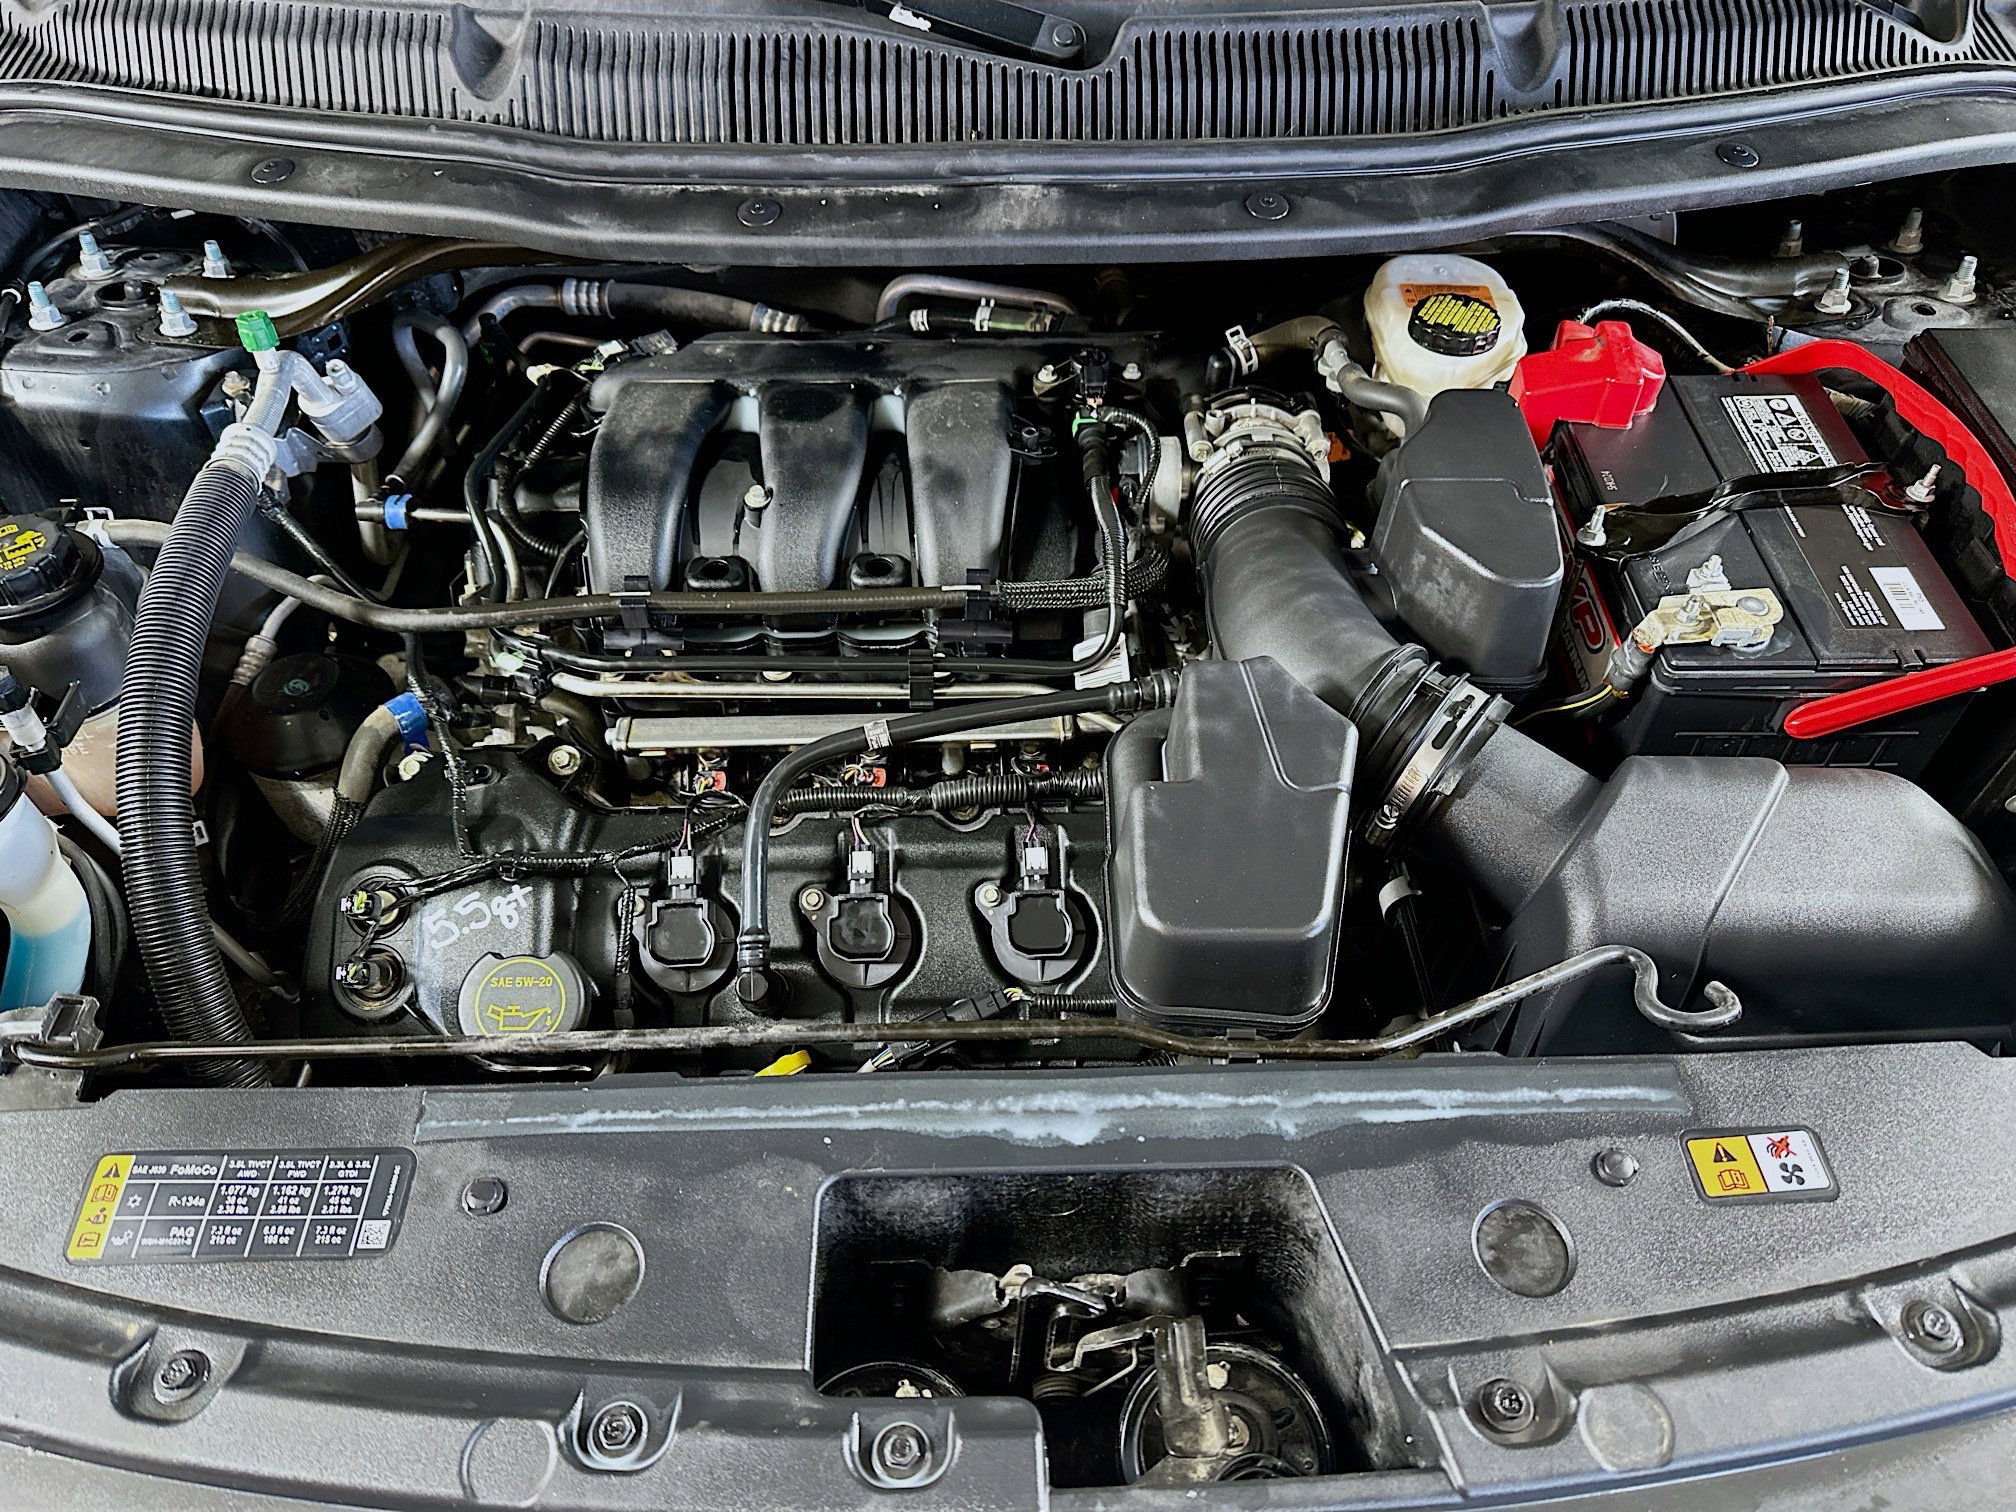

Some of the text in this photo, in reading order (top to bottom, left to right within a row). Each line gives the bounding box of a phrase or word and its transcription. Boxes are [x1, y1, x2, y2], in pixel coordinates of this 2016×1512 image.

[1801, 417, 1836, 468] DANGER POISO
[490, 976, 553, 988] SAE 5W-20
[170, 1164, 218, 1176] FoMoCo
[237, 1169, 258, 1178] AWD
[247, 1184, 260, 1198] kg
[299, 1184, 312, 1198] kg
[350, 1185, 362, 1198] kg
[168, 1195, 206, 1207] R-134a
[169, 1226, 195, 1238] PAG
